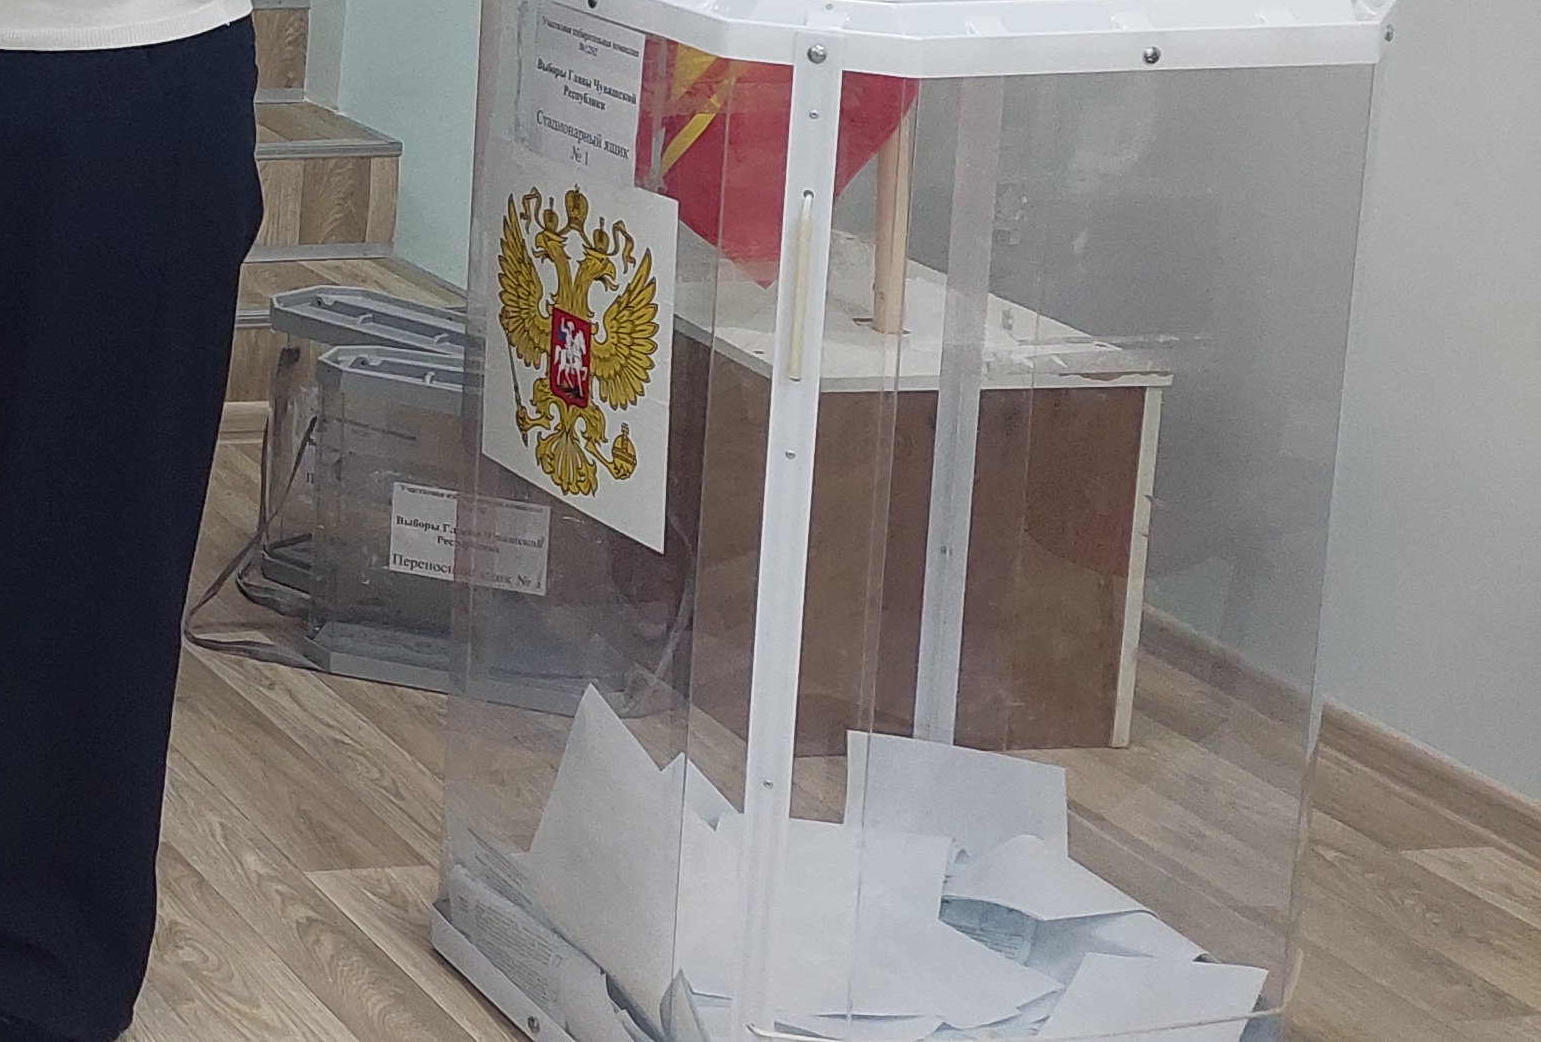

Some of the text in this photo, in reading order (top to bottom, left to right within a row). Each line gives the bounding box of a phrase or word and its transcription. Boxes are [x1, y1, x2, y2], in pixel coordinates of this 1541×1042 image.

[537, 58, 637, 105] Выборы Главы Чувашской
[563, 84, 606, 110] Республики
[536, 109, 630, 160] Стационарный ящик
[396, 515, 440, 532] Выборы
